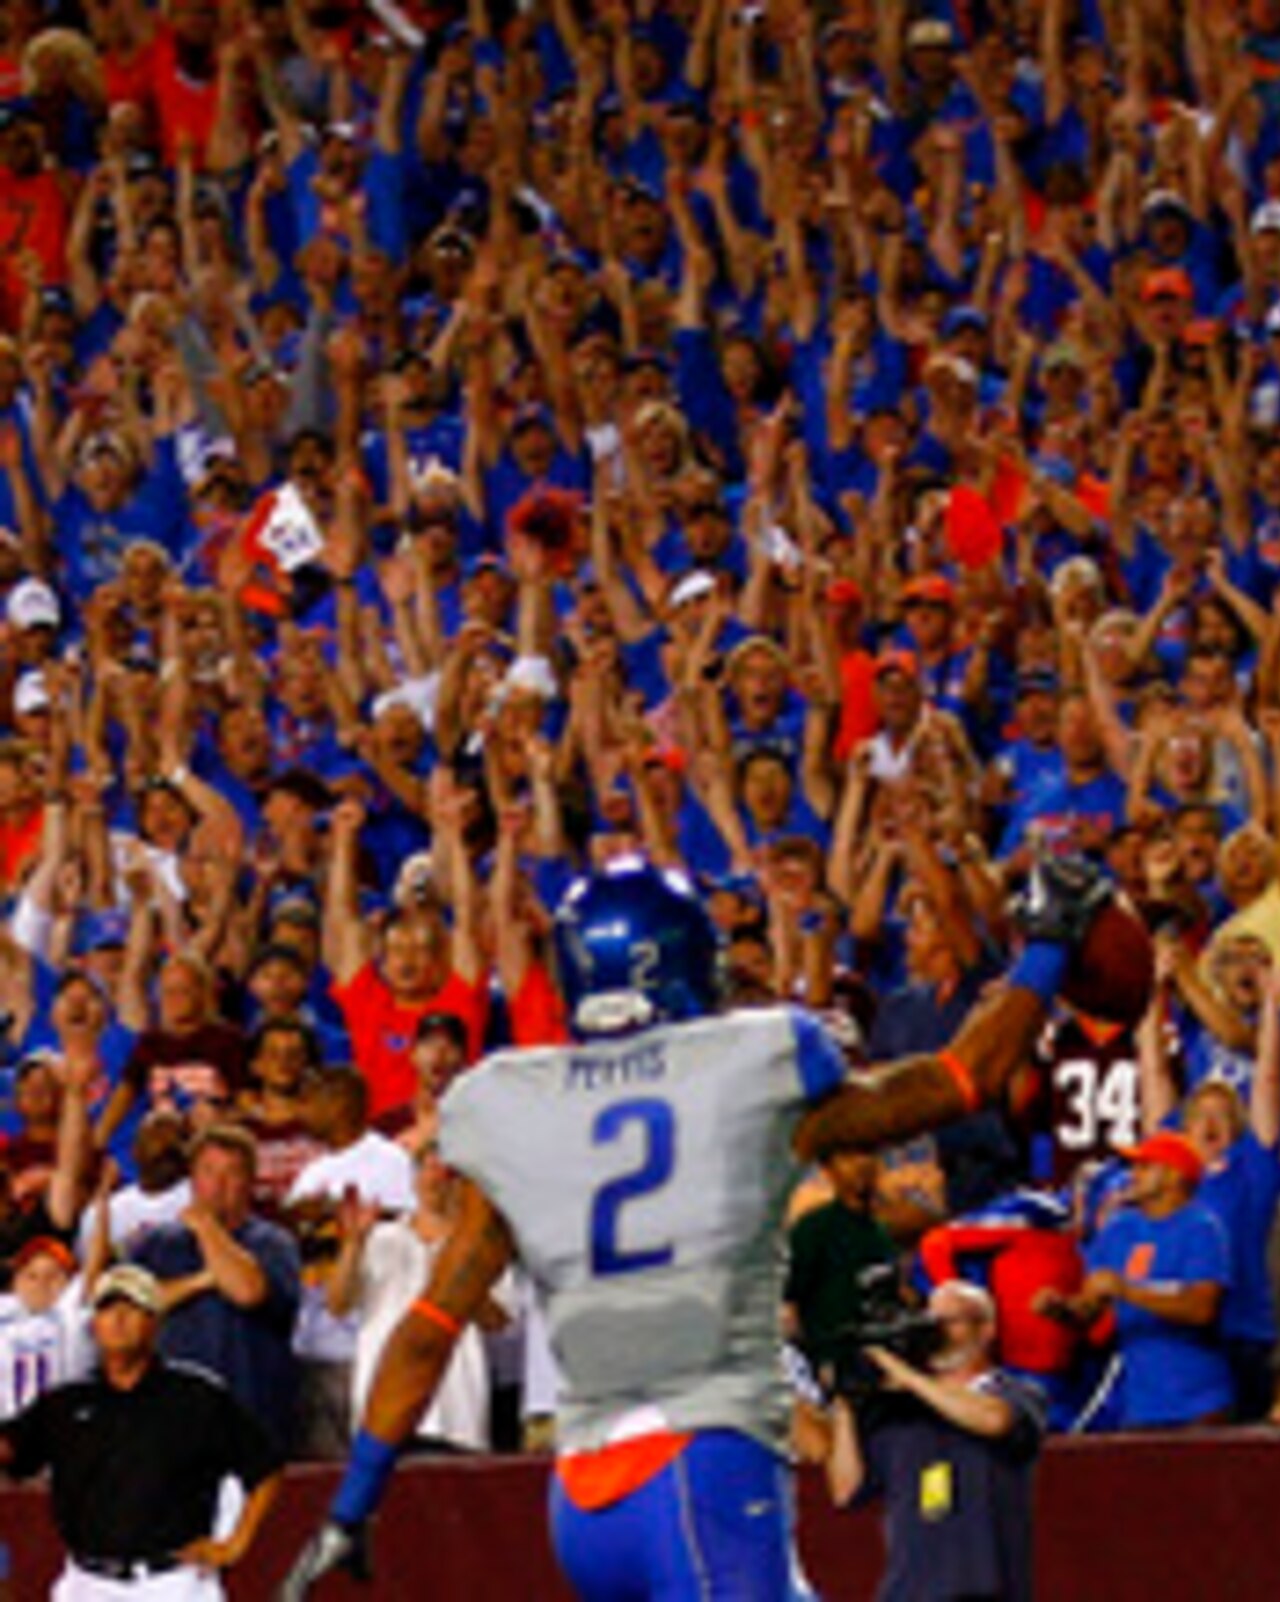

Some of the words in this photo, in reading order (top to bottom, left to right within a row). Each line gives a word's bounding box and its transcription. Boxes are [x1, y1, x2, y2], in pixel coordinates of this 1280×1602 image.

[628, 940, 662, 989] 2
[1053, 1058, 1137, 1148] 34
[589, 1099, 676, 1278] 2
